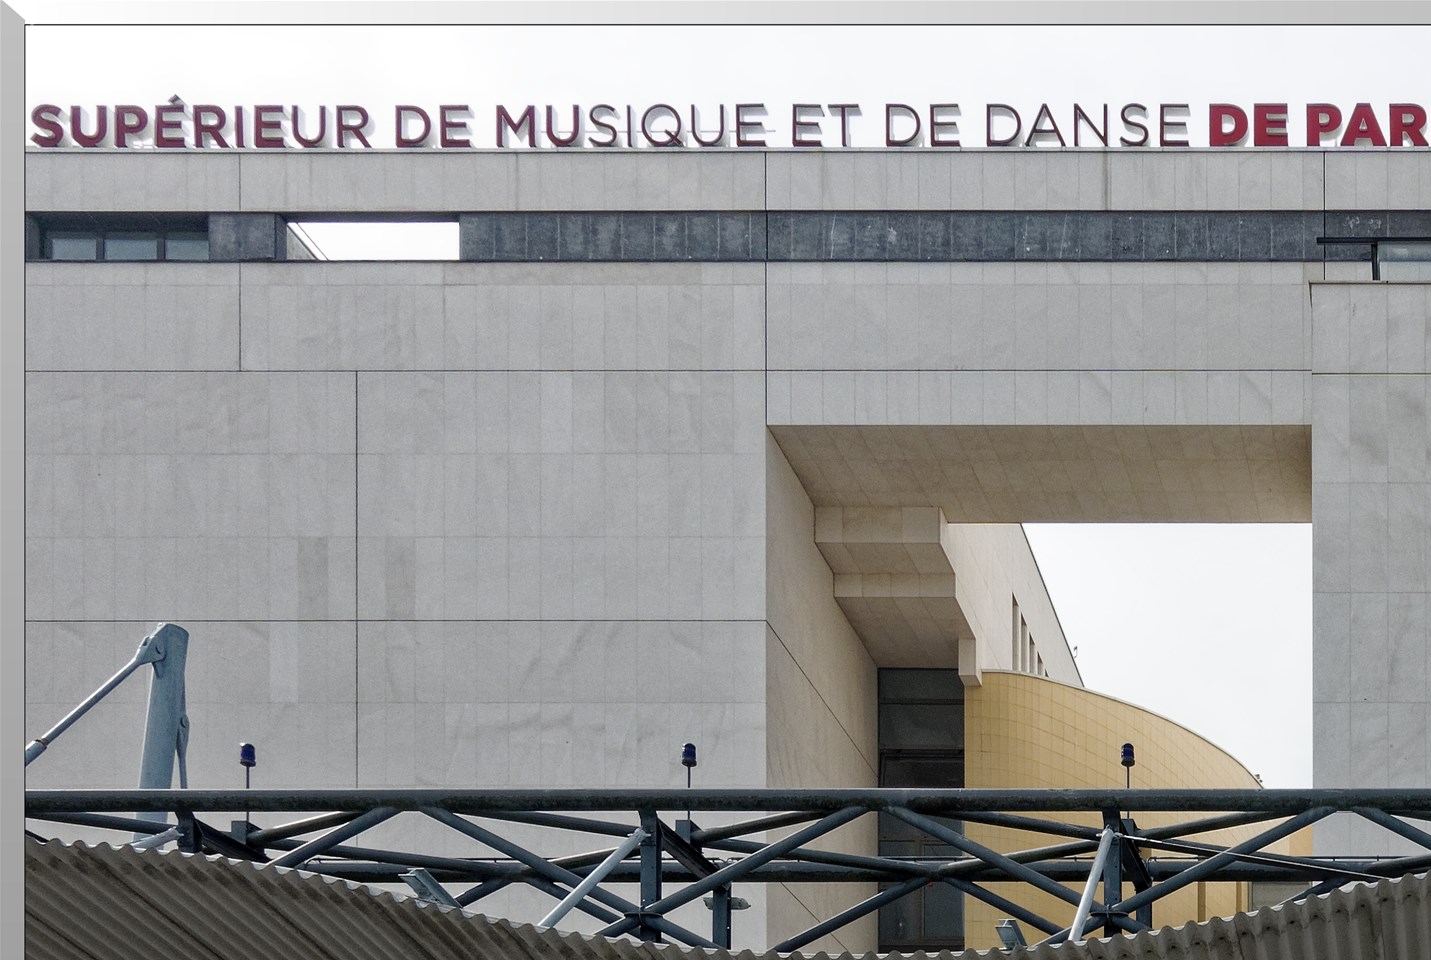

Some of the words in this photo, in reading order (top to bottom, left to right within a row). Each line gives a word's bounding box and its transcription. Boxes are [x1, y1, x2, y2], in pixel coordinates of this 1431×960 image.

[30, 94, 372, 149] SUPÉRIEUR
[394, 103, 473, 149] DE
[496, 103, 768, 149] MUSIQUE
[792, 103, 860, 148] ET
[886, 103, 961, 148] DE
[986, 102, 1190, 148] DANSE
[1208, 103, 1289, 148] DE
